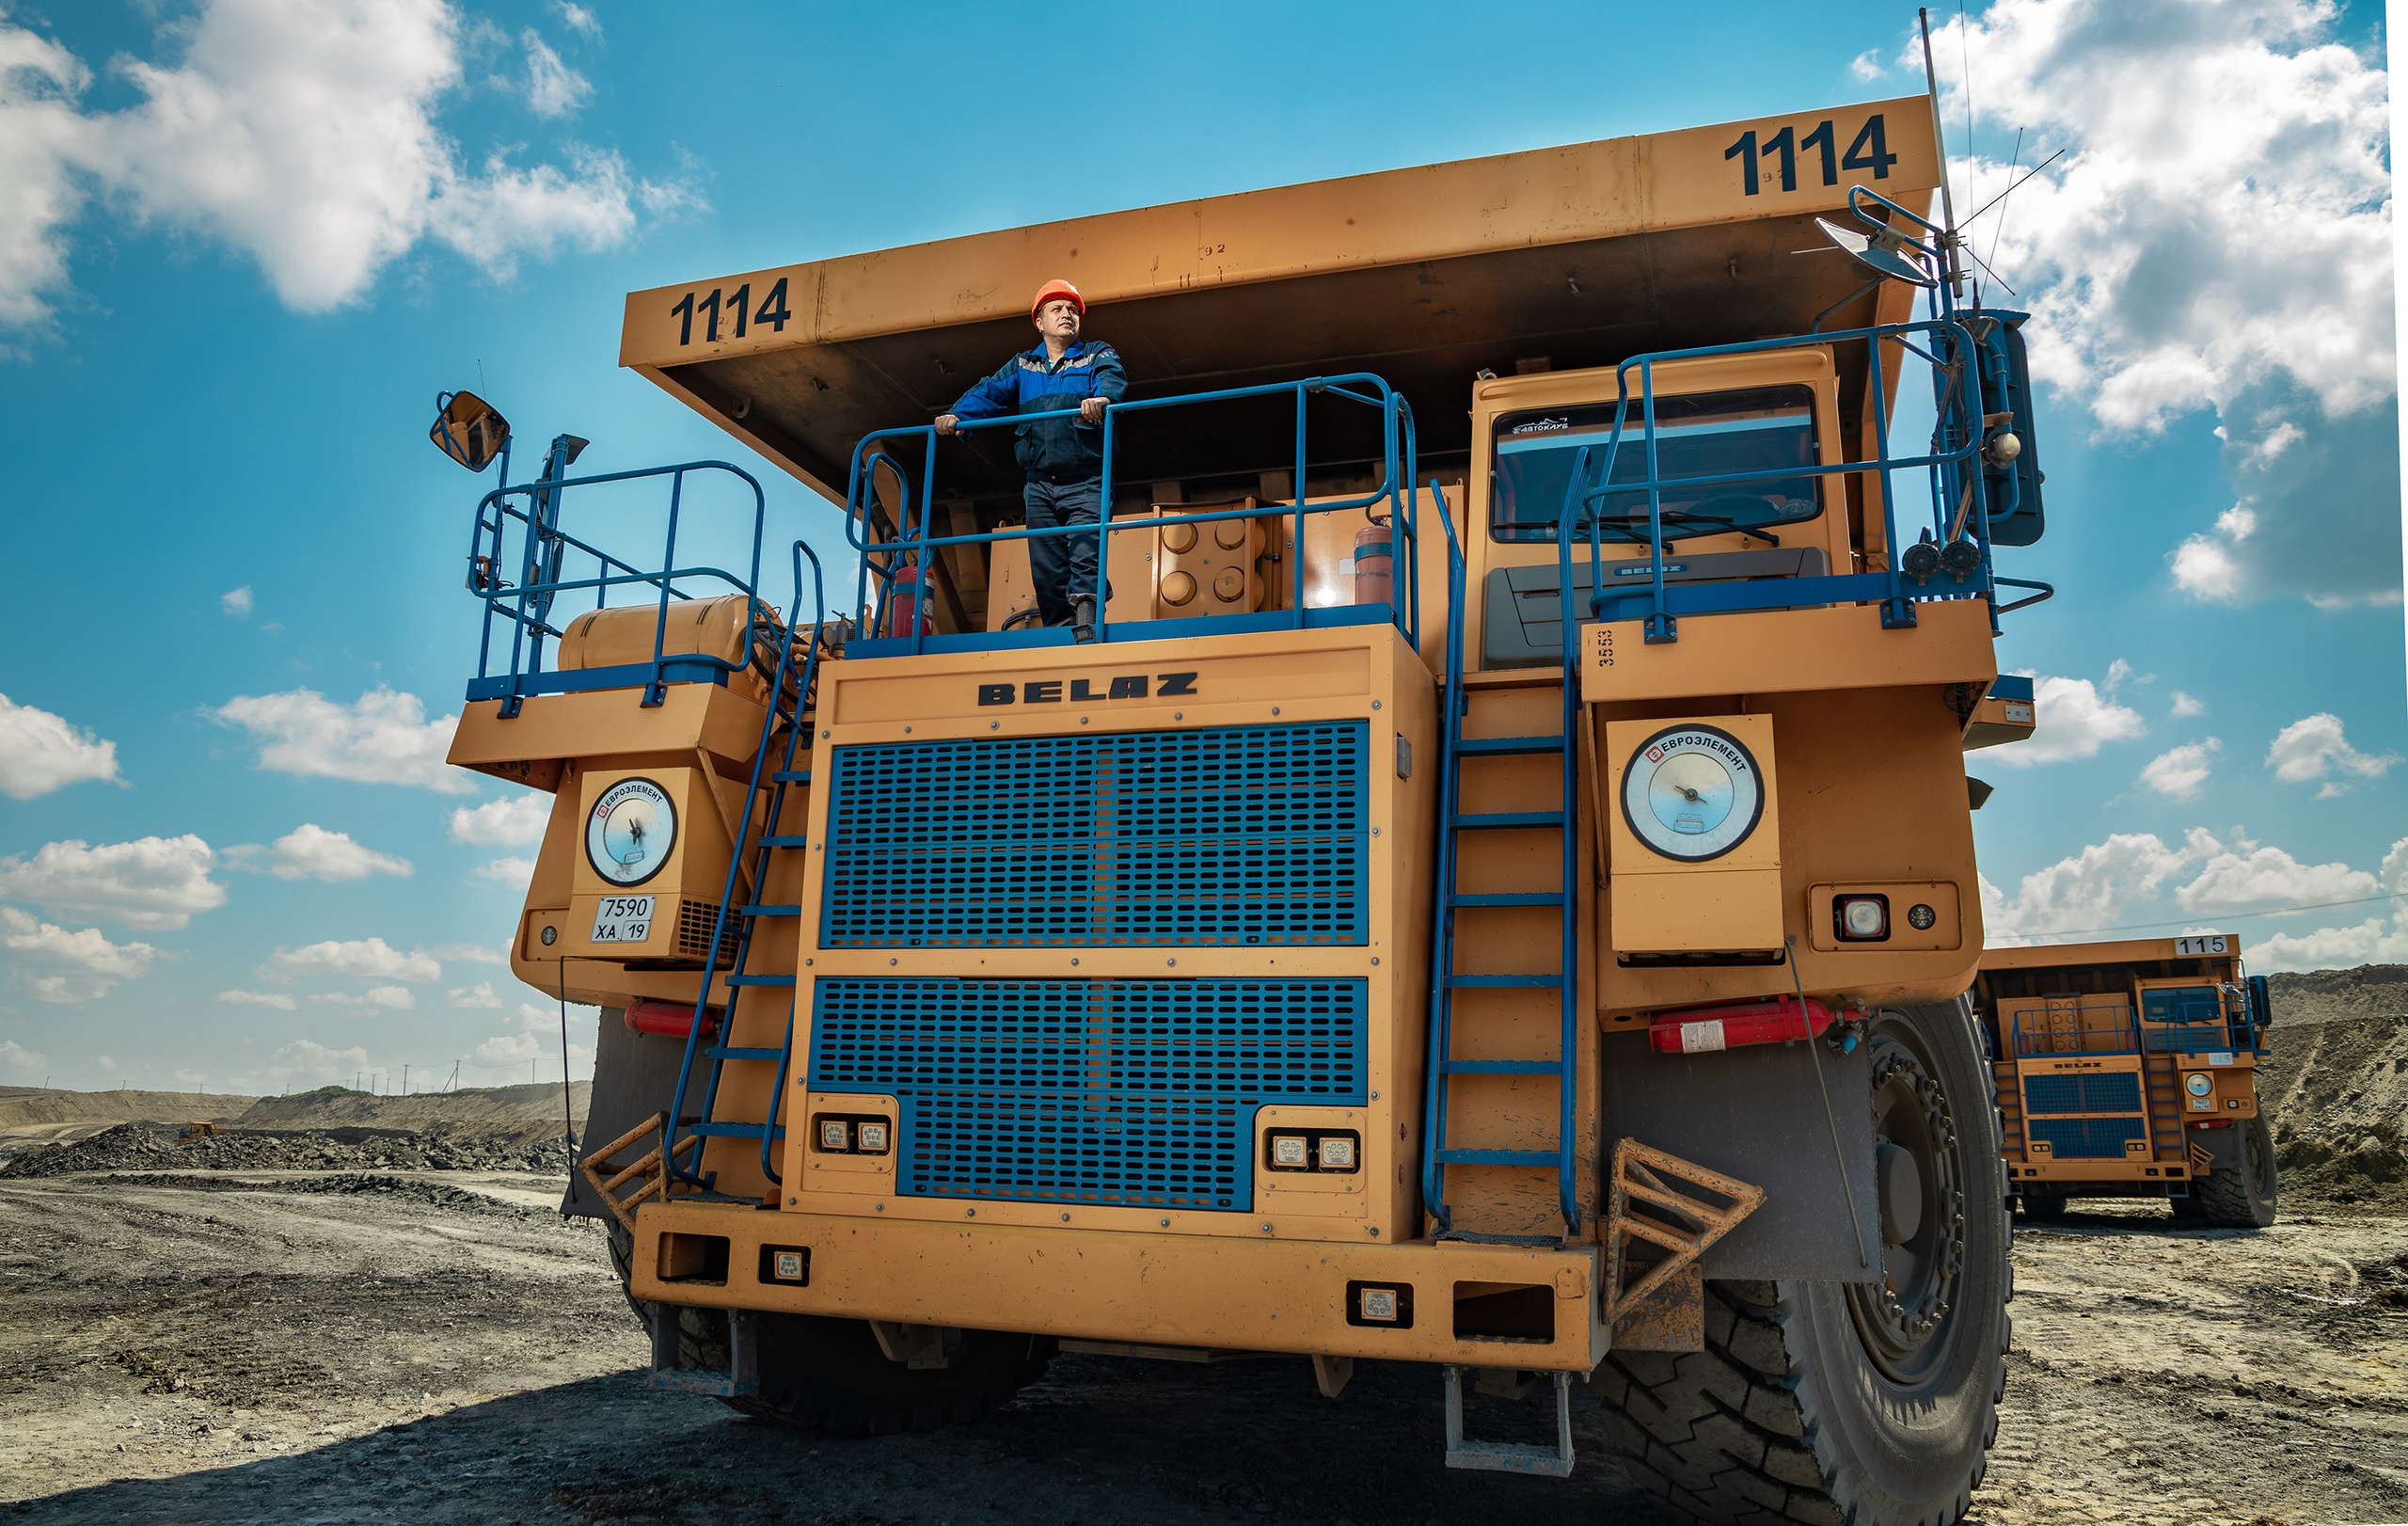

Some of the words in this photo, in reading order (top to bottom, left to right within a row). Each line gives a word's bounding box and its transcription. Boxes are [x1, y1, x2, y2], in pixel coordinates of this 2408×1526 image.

[1724, 114, 1897, 196] 1114
[671, 278, 791, 346] 1114
[1597, 629, 1614, 667] 3553
[978, 672, 1198, 707] BELAZ
[1660, 736, 1747, 771] ЕВРОЭЛЕМЕНТ
[605, 785, 663, 807] ЕВРОЭЛЕМЕНТ
[605, 898, 648, 917] 7590
[595, 924, 616, 939] ХА
[627, 923, 645, 939] 19
[2179, 936, 2225, 954] 115
